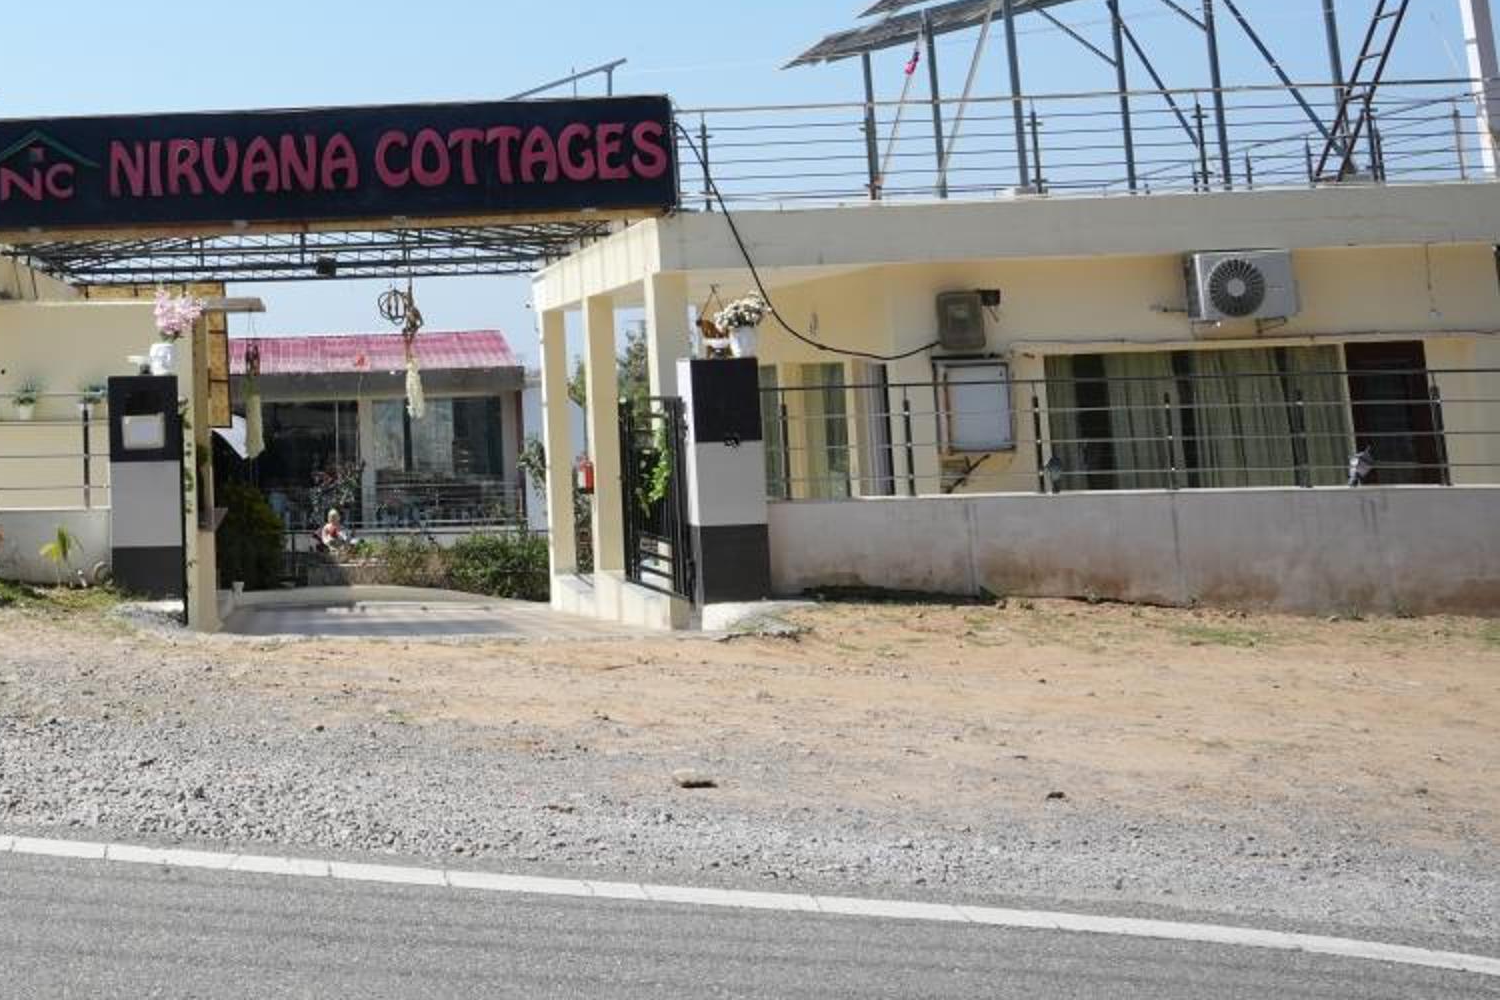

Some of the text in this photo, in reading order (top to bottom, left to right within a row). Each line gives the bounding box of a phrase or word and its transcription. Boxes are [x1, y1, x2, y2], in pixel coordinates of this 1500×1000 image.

[1, 163, 74, 201] NC
[110, 120, 666, 196] NIRVANA COTTAGES
